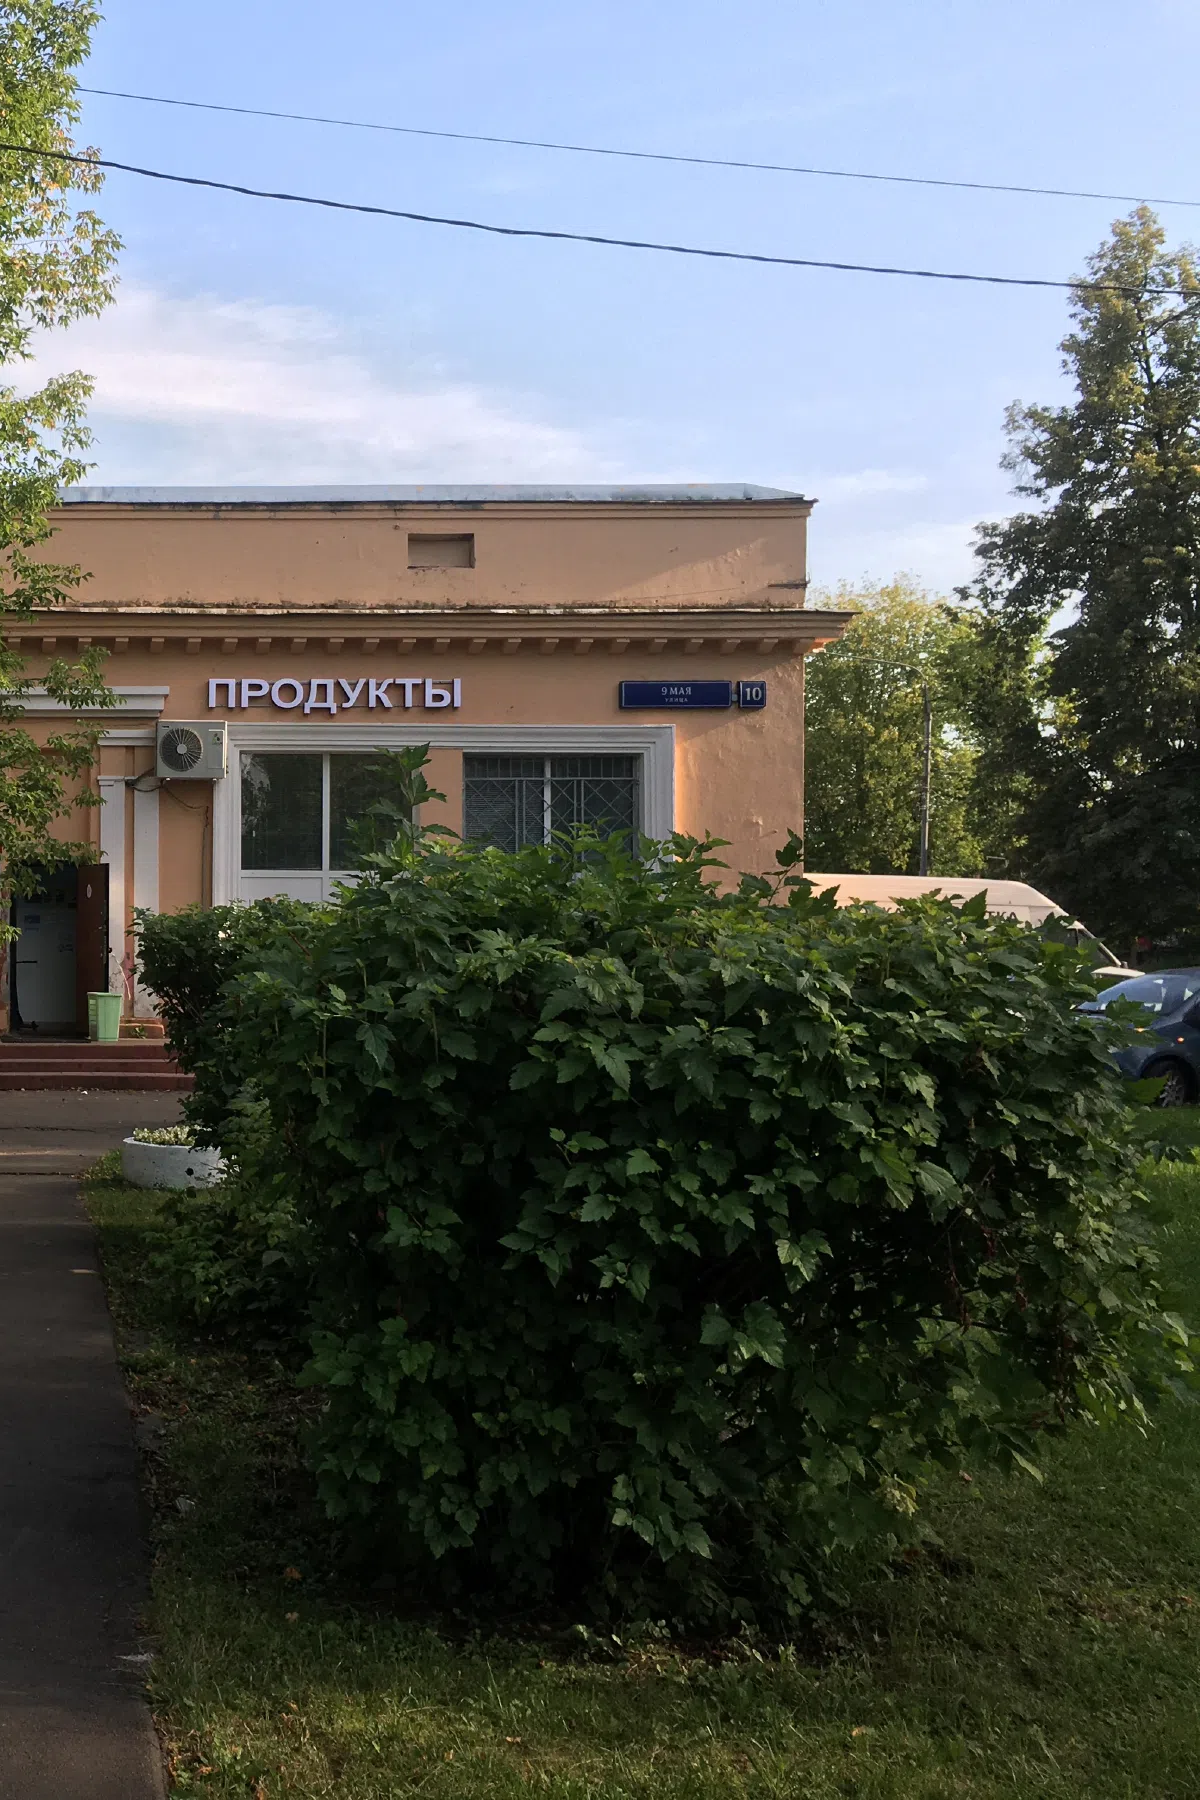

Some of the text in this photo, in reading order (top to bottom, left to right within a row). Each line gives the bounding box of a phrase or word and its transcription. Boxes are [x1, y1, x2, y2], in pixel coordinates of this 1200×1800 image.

[207, 678, 462, 714] ПРОДУКТЫ
[661, 686, 692, 696] 9 МАЯ
[745, 687, 762, 701] 10
